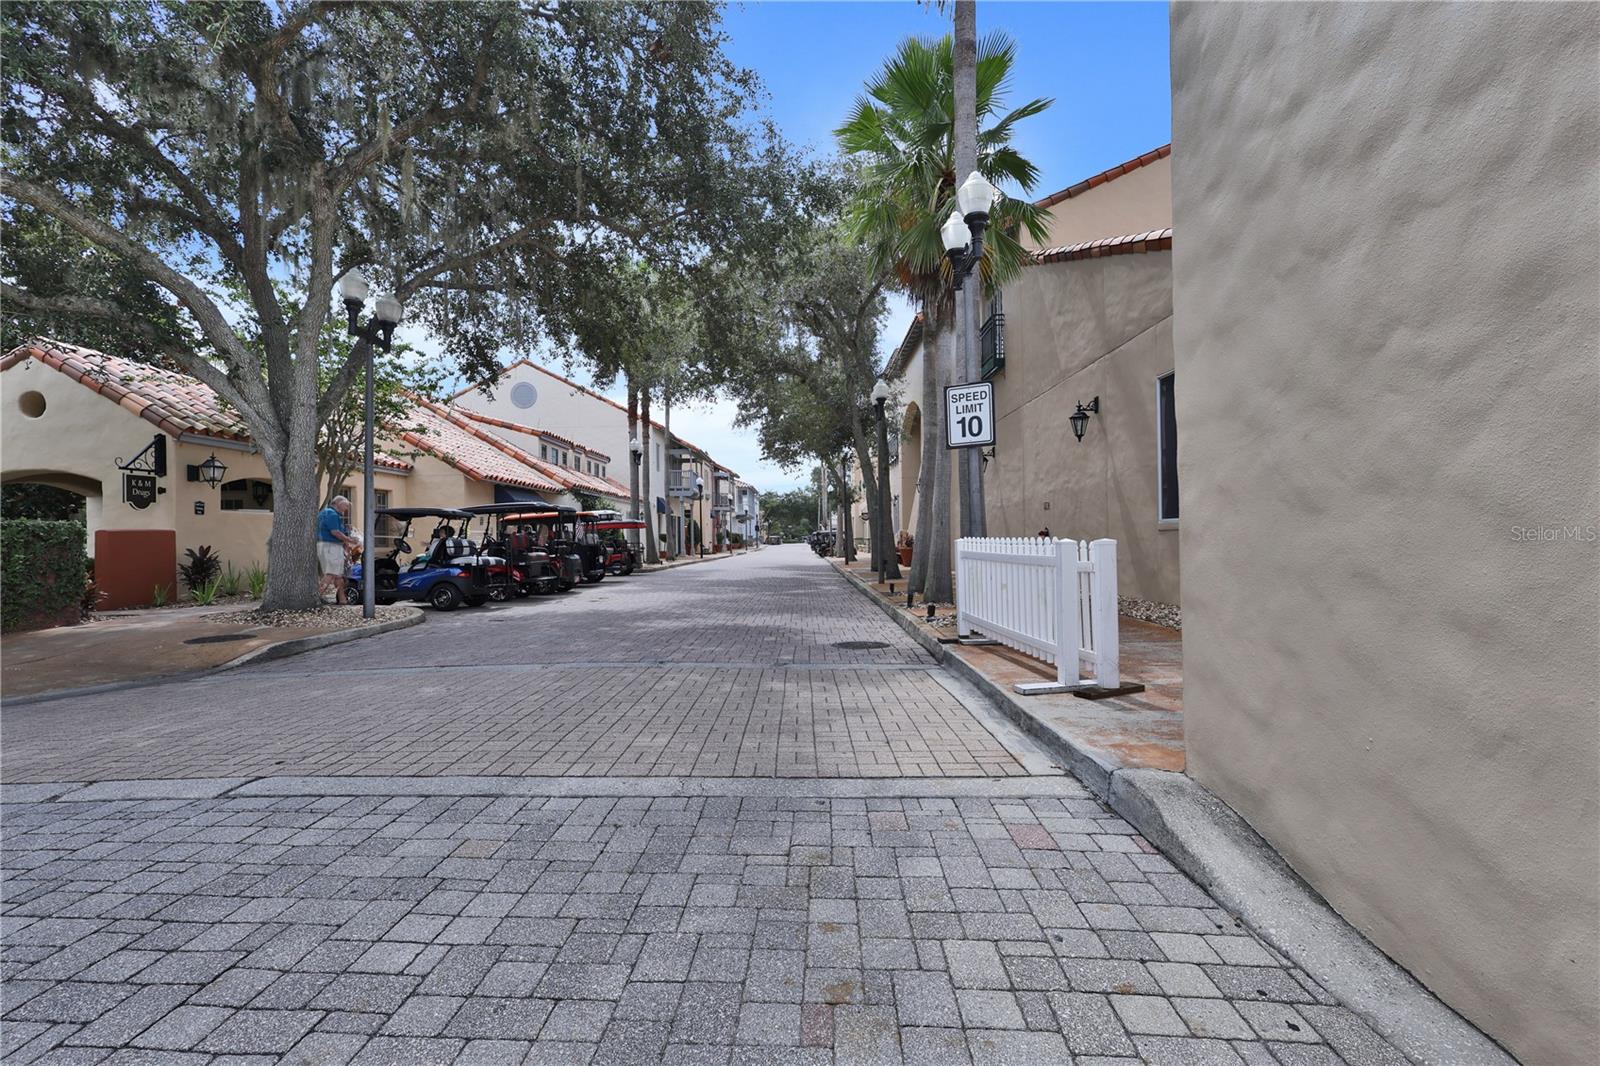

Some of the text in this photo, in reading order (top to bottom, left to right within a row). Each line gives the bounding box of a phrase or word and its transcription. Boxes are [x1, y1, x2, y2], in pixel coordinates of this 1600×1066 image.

[951, 390, 988, 403] SPEED
[956, 403, 984, 414] LIMIT
[956, 416, 983, 438] 10
[130, 479, 136, 487] K
[132, 487, 151, 498] Drugs
